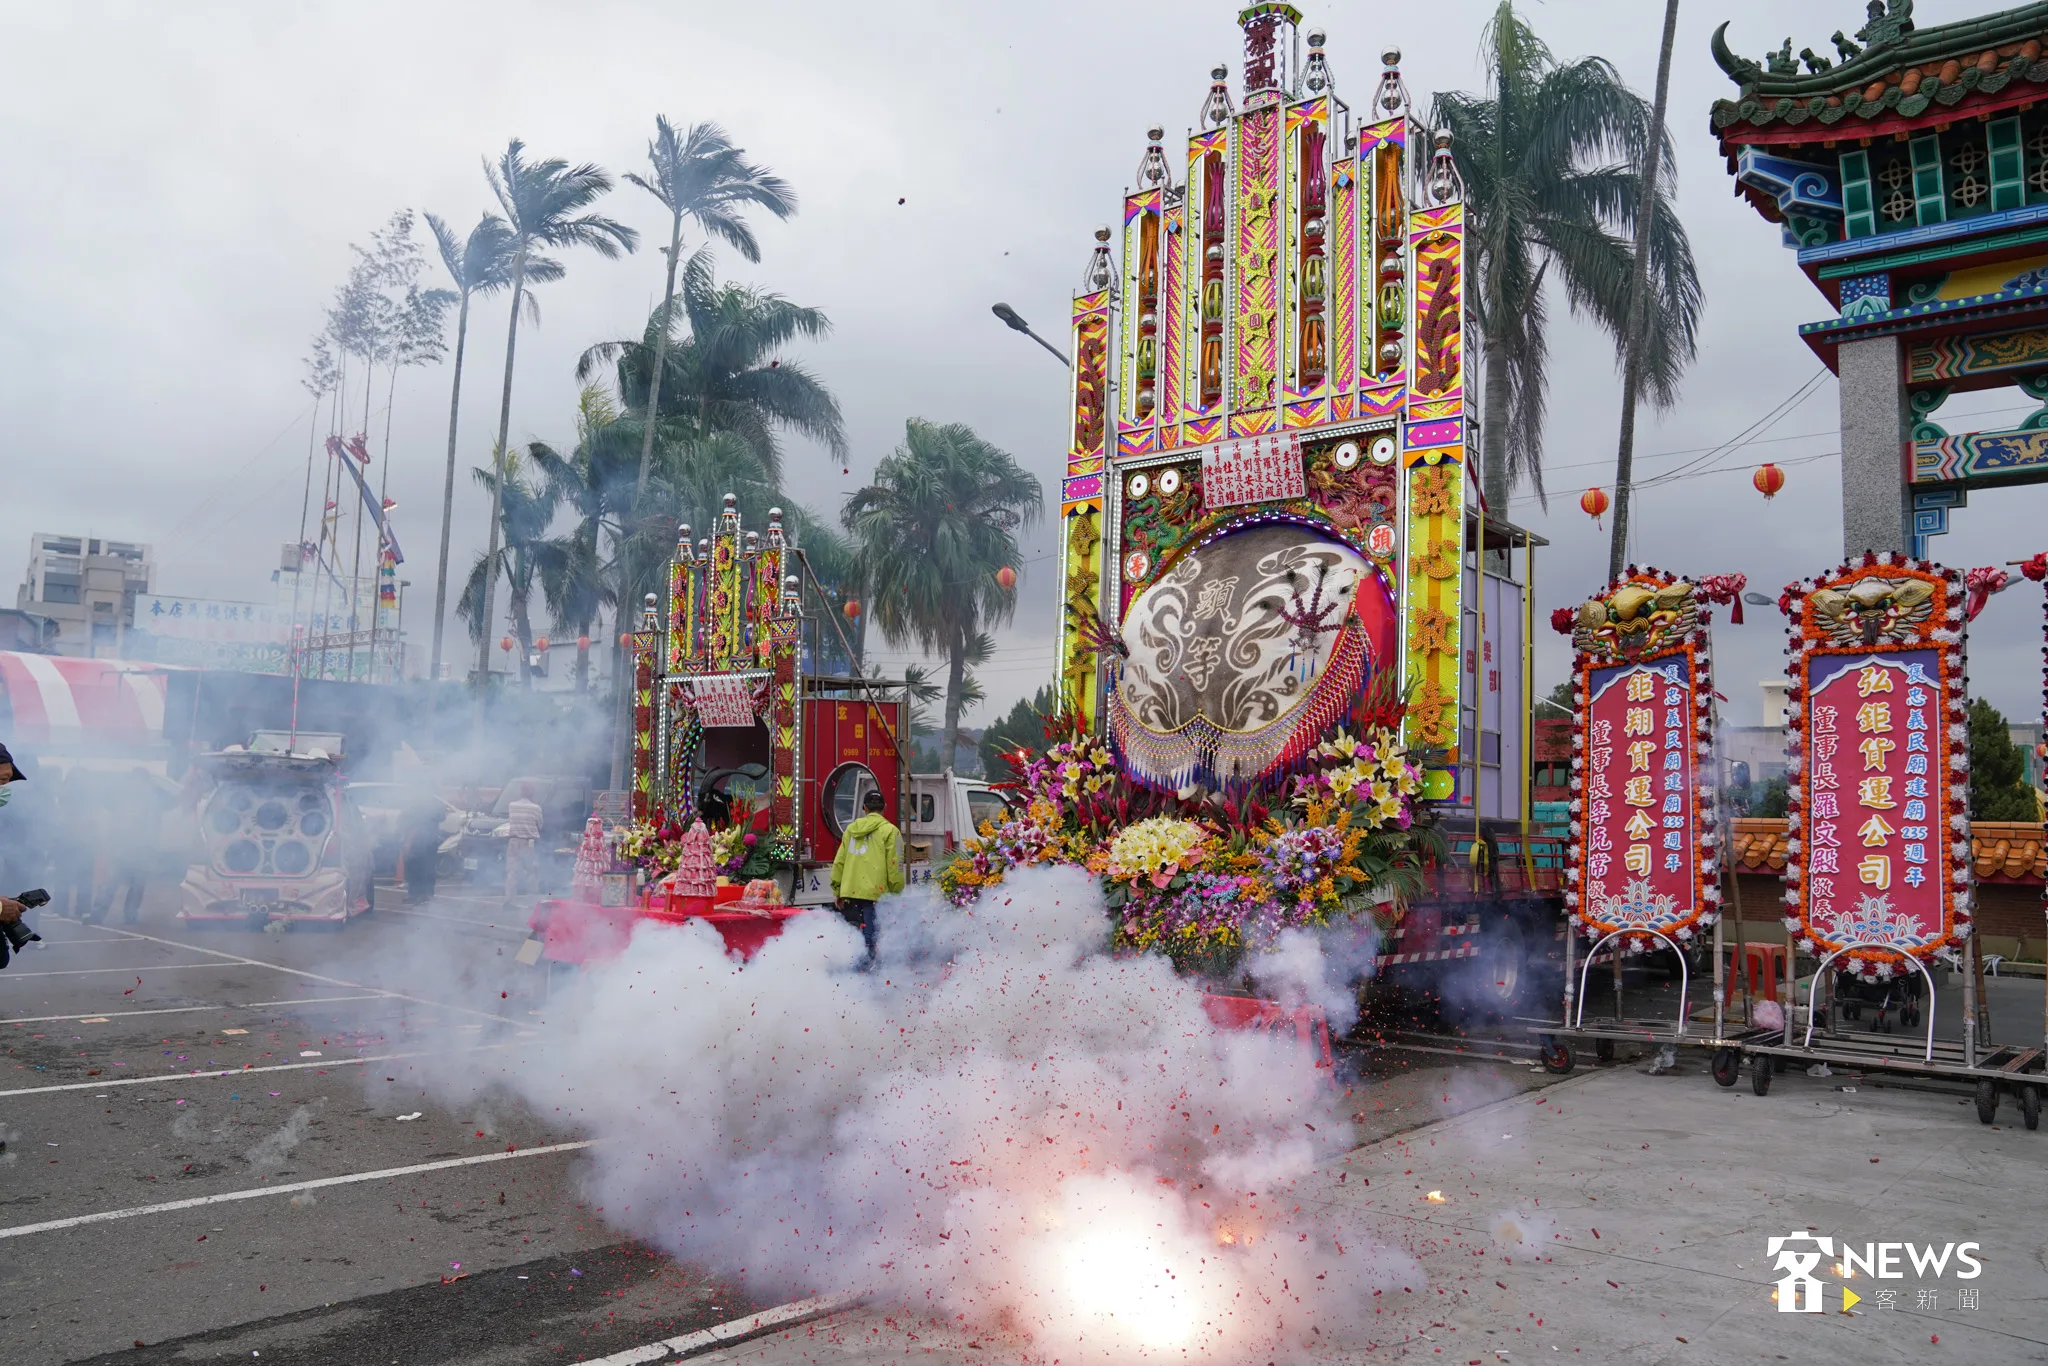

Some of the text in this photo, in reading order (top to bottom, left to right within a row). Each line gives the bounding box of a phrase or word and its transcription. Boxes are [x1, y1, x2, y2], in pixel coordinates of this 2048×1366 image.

[1129, 555, 1145, 577] 等
[1263, 456, 1276, 499] 羅文殿
[1283, 450, 1295, 499] 李克常
[1372, 527, 1391, 550] 頭
[1182, 576, 1240, 692] 頭等
[1407, 465, 1459, 744] 誠心敬意
[1588, 720, 1612, 918] 董事長李克常敬奉
[1624, 672, 1658, 877] 鉅翔貨運公司
[1661, 664, 1684, 873] 褒忠義民廟建廟235週年
[1809, 706, 1839, 922] 董事長羅文殿敬奉
[1856, 666, 1896, 890] 弘鉅貨運公司
[1901, 663, 1929, 888] 褒忠義民廟建廟235週年
